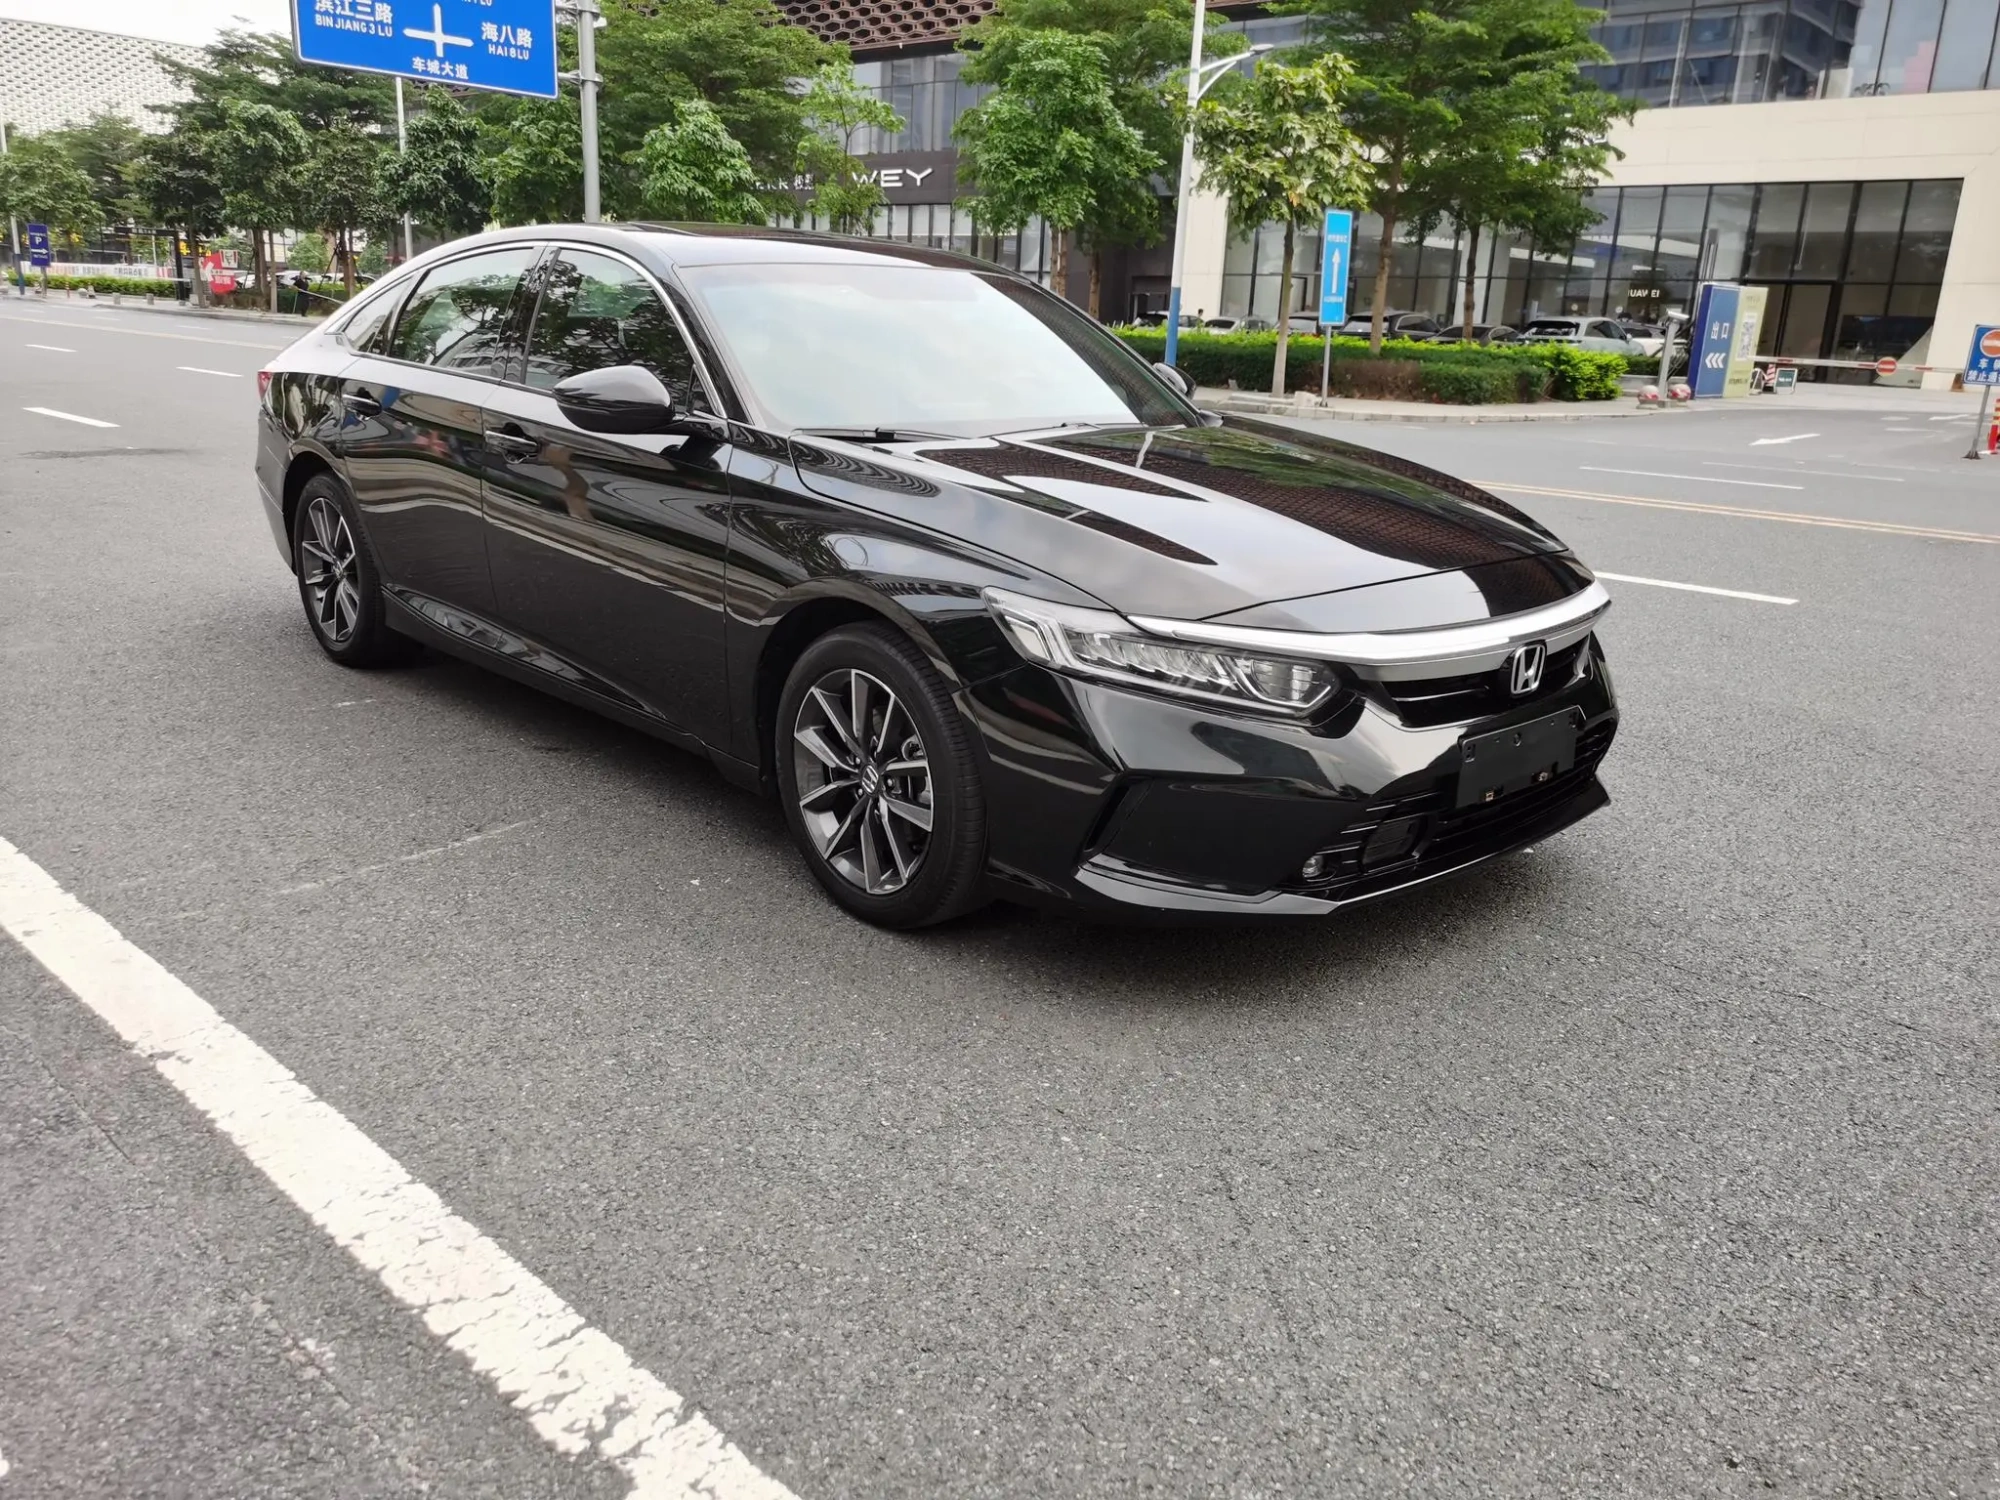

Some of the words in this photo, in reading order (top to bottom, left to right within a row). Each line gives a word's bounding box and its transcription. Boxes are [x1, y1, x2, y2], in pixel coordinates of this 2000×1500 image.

[368, 22, 375, 34] 3
[378, 24, 393, 37] LU
[481, 21, 533, 49] 海八路
[517, 50, 530, 60] LU
[412, 56, 469, 79] 车城大道
[851, 168, 933, 188] WEY
[35, 236, 42, 245] P
[1711, 321, 1730, 340] 出口
